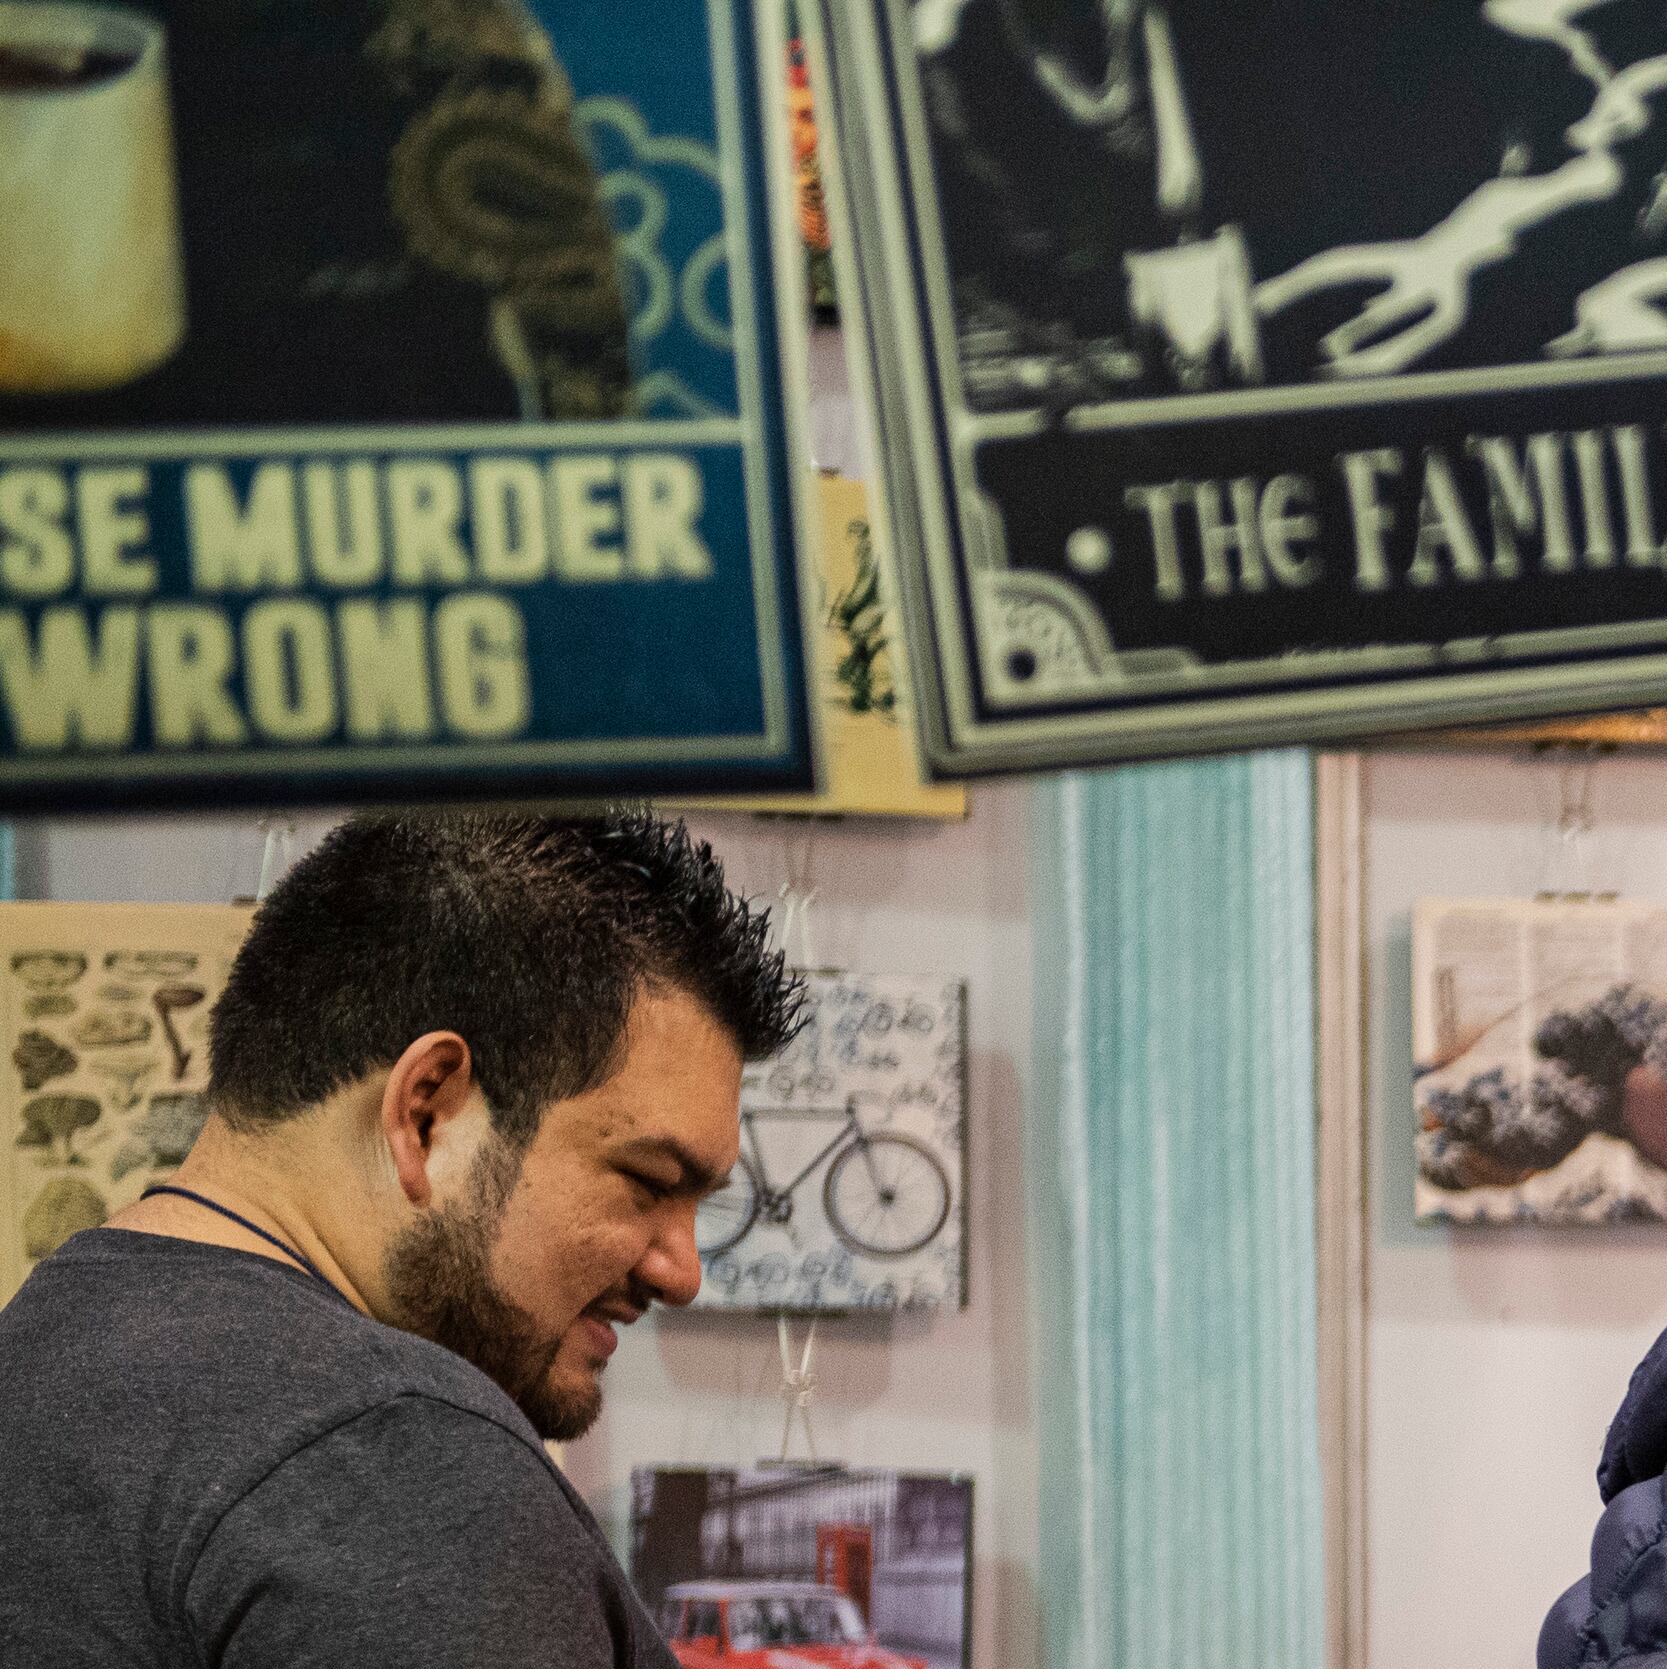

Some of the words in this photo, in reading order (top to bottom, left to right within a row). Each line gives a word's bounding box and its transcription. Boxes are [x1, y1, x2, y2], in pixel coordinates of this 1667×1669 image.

[185, 453, 714, 591] MURDER
[1126, 473, 1323, 600] THE
[0, 592, 532, 750] WRONG
